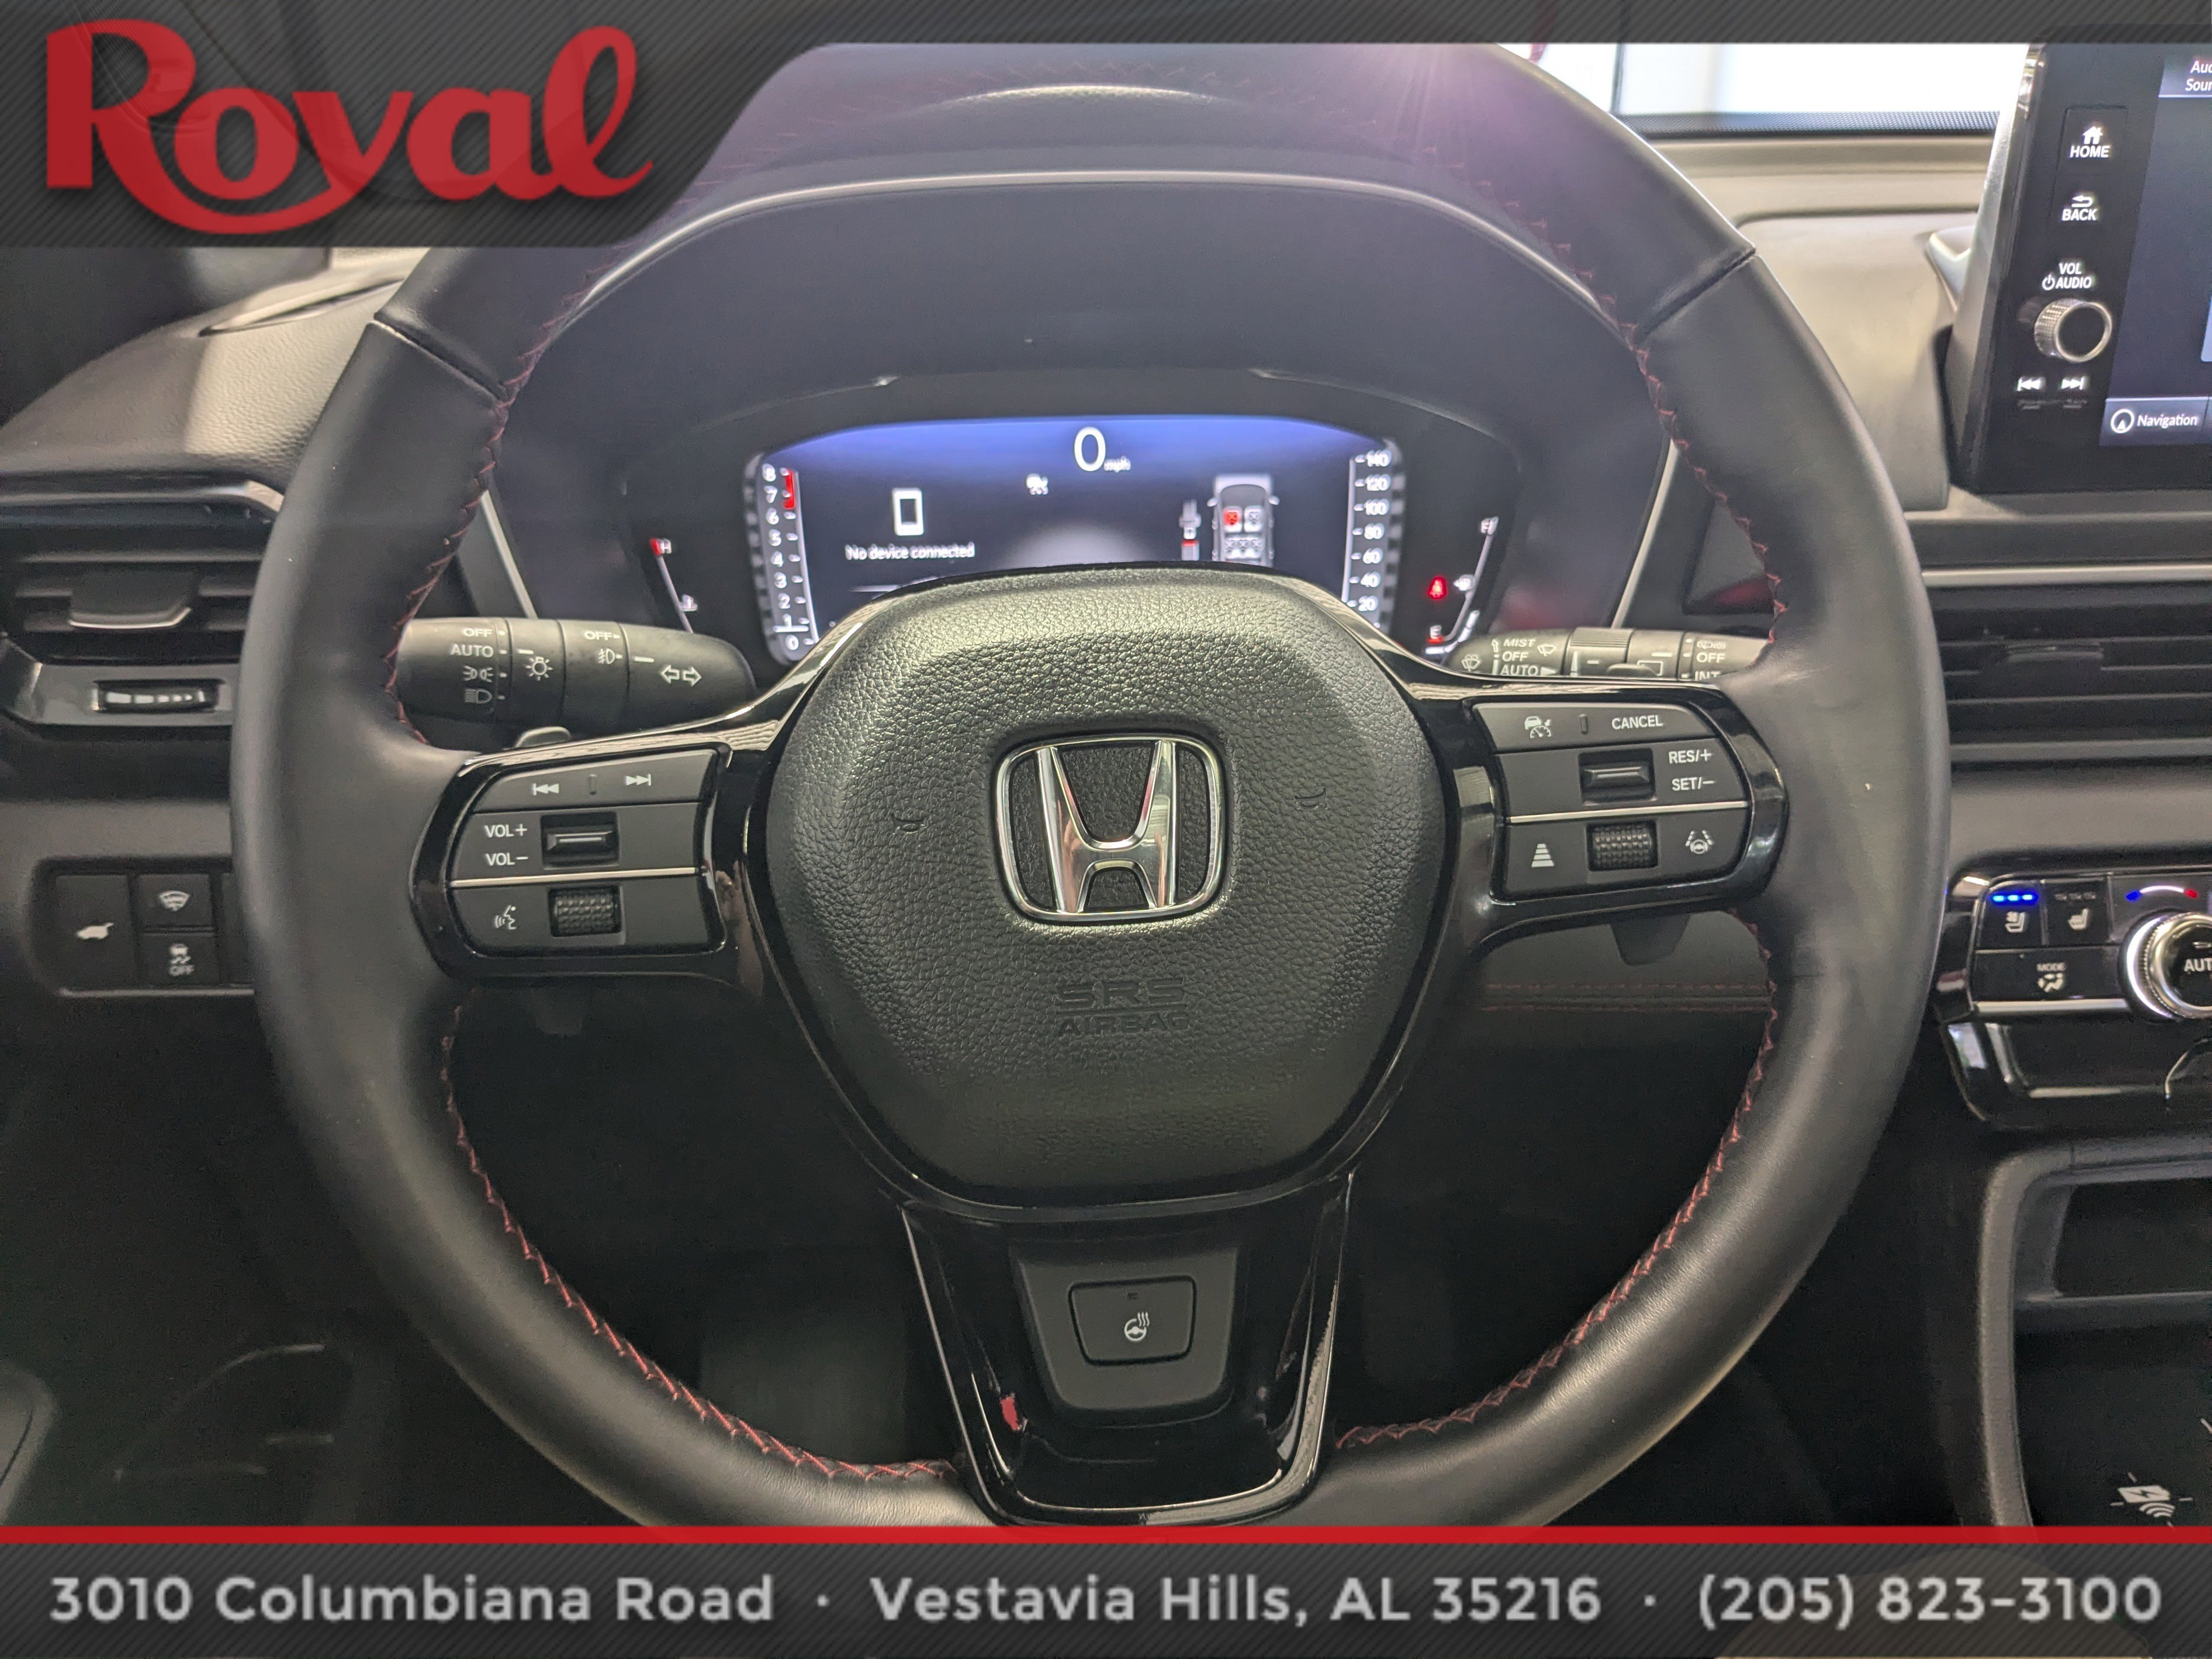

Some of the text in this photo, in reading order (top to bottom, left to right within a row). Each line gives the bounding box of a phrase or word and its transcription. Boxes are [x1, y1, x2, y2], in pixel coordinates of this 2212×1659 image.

[2070, 145, 2109, 158] HOME
[2062, 208, 2097, 221] BACK
[2059, 263, 2082, 275] VOL
[2056, 276, 2092, 290] AUDIO
[2137, 414, 2198, 429] Navigation
[1074, 427, 1106, 472] 0
[1366, 450, 1391, 466] 140
[762, 464, 776, 482] 8
[1365, 473, 1391, 491] 120
[764, 486, 778, 504] 7
[1364, 498, 1390, 515] 100
[766, 507, 779, 525] 6
[769, 529, 782, 546] 5
[1364, 523, 1385, 540] 80
[770, 550, 783, 567] 4
[845, 541, 975, 560] No device connected
[1363, 548, 1383, 564] 60
[774, 572, 787, 589] 3
[1361, 572, 1381, 588] 40
[778, 592, 791, 609] 2
[1358, 595, 1379, 611] 20
[463, 628, 492, 638] OFF
[584, 630, 612, 641] OFF
[451, 644, 494, 657] AUTO
[1503, 639, 1536, 647] MIST
[1502, 651, 1528, 662] OFF
[1696, 652, 1725, 663] OFF
[1502, 665, 1539, 676] AUTO
[1611, 715, 1663, 730] CANCEL
[1668, 749, 1713, 764] RES/+
[1672, 777, 1715, 791] SET/-
[169, 966, 195, 976] OFF
[1057, 978, 1186, 1010] SRS
[1058, 1012, 1190, 1037] AIRBAG
